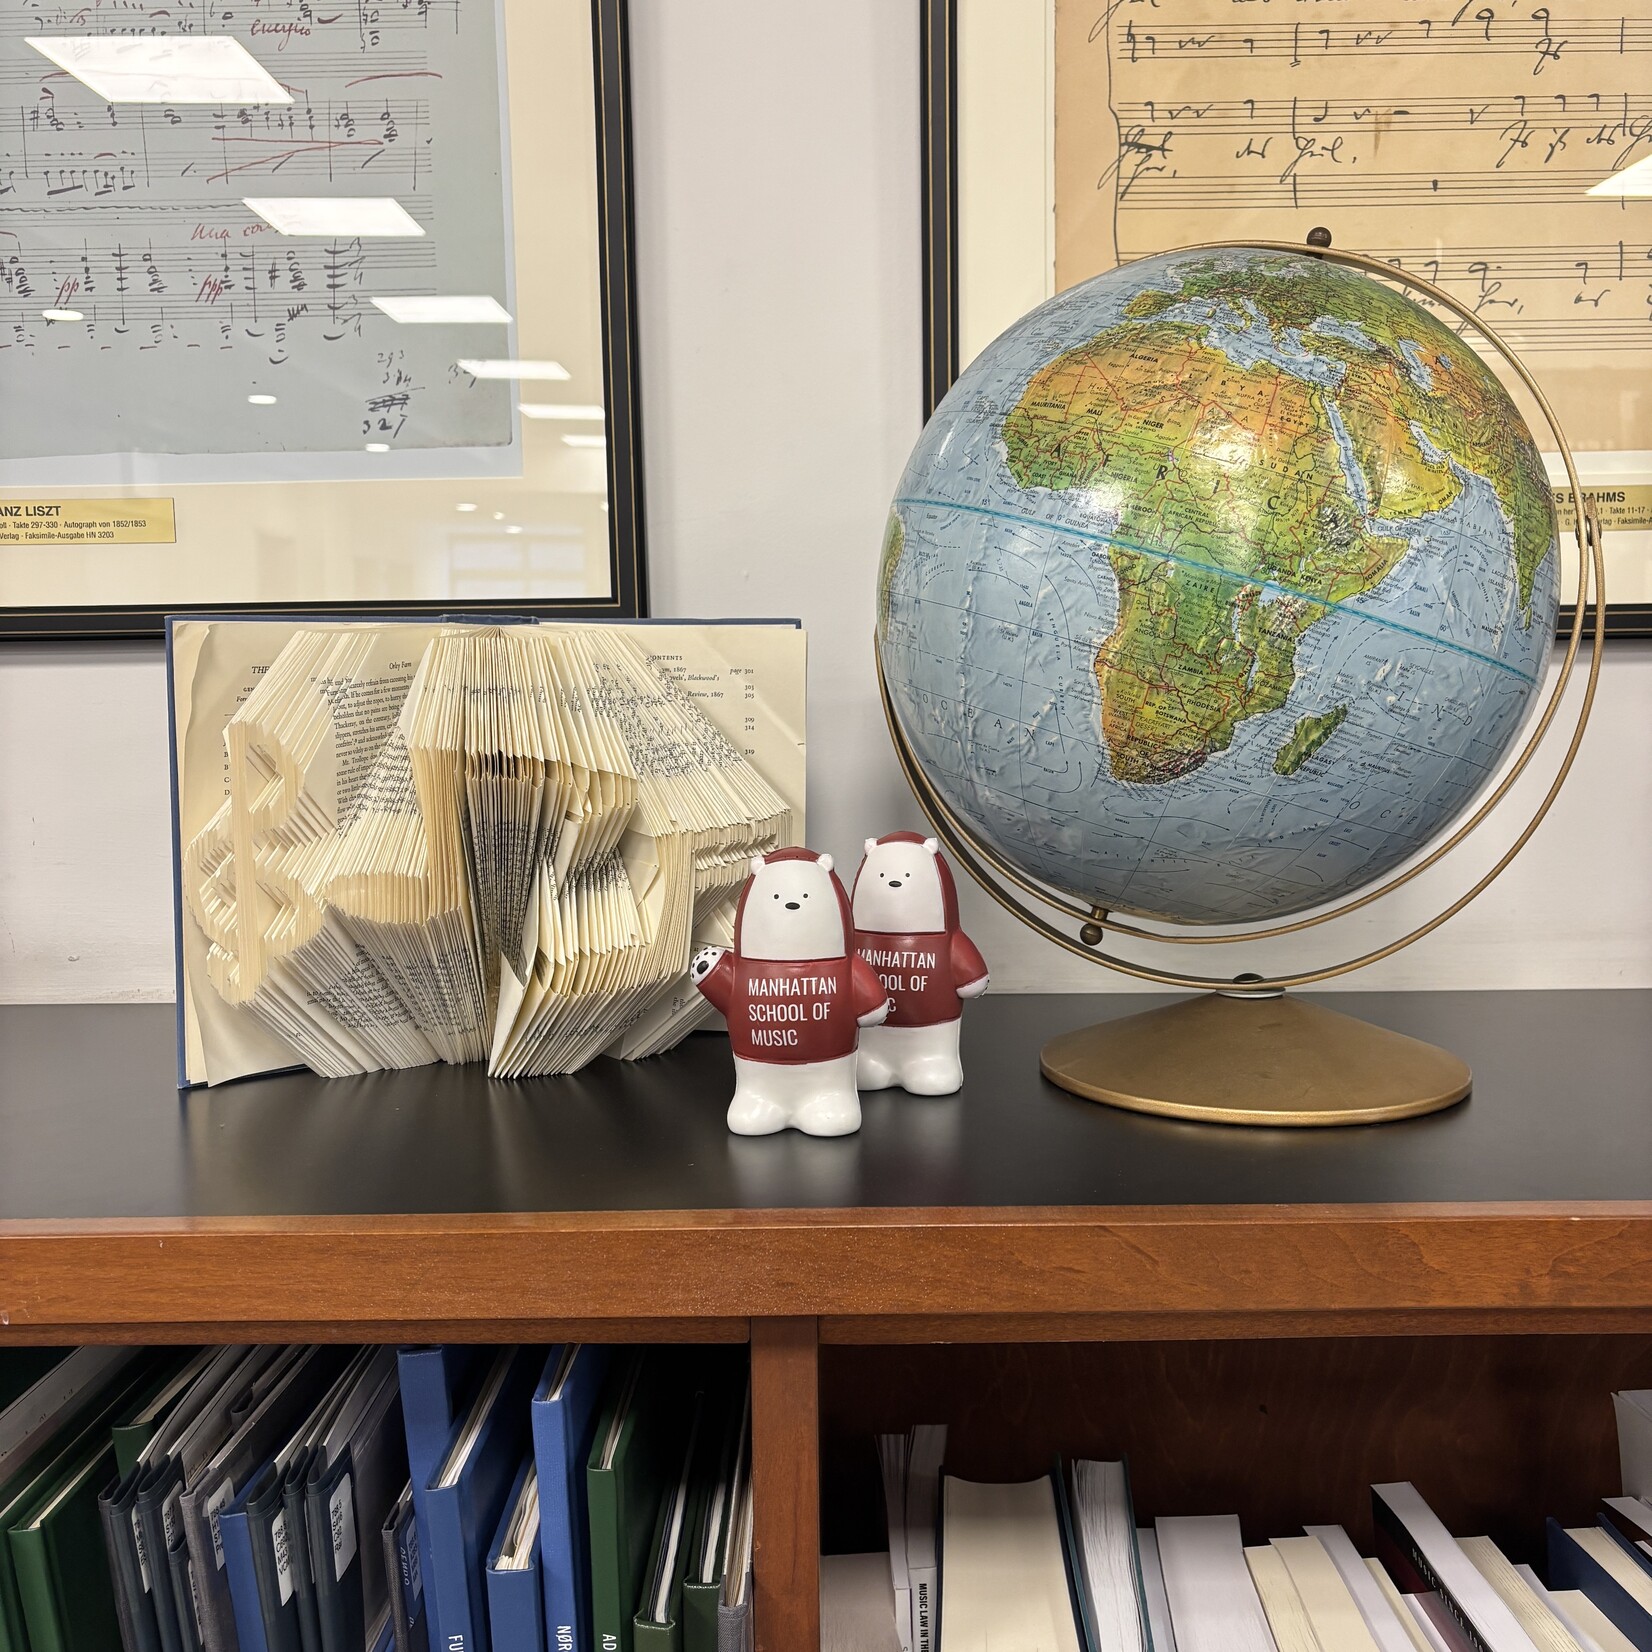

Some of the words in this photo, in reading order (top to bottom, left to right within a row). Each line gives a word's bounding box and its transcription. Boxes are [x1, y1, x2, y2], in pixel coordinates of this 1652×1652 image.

[1129, 352, 1158, 363] ALGERIA
[1031, 401, 1066, 410] MAURITANIA
[1142, 420, 1164, 430] NIGER
[1280, 416, 1309, 428] EGYPT
[1259, 460, 1313, 480] SUDAN
[1111, 472, 1138, 484] NIGERIA
[1439, 490, 1453, 504] OMAN
[26, 506, 61, 516] LISZT
[1168, 510, 1193, 521] AFRICAN
[1184, 508, 1209, 518] CENTRAL
[64, 521, 97, 530] Autograph
[25, 532, 84, 540] Faksimile-Ausgabe
[1117, 564, 1136, 576] CONGO
[1365, 559, 1388, 582] SOMALIA
[1186, 580, 1215, 593] ZAIRE
[1301, 574, 1323, 586] KENYA
[1258, 628, 1292, 643] TANZANIA
[1178, 664, 1204, 676] ZAMBIA
[1187, 699, 1221, 713] RHODESIA
[1155, 710, 1187, 724] BOTSWANA
[1116, 752, 1139, 765] SOUTH
[748, 977, 837, 996] MANHATTAN
[879, 974, 906, 991] OOL
[910, 976, 928, 991] OF
[749, 1003, 808, 1022] SCHOOL
[813, 1002, 830, 1020] OF
[752, 1029, 798, 1046] MUSIC
[919, 1583, 928, 1609] MUSIC
[920, 1610, 928, 1627] LAW
[920, 1629, 929, 1637] IN
[448, 1634, 464, 1652] FU
[602, 1634, 617, 1650] AD
